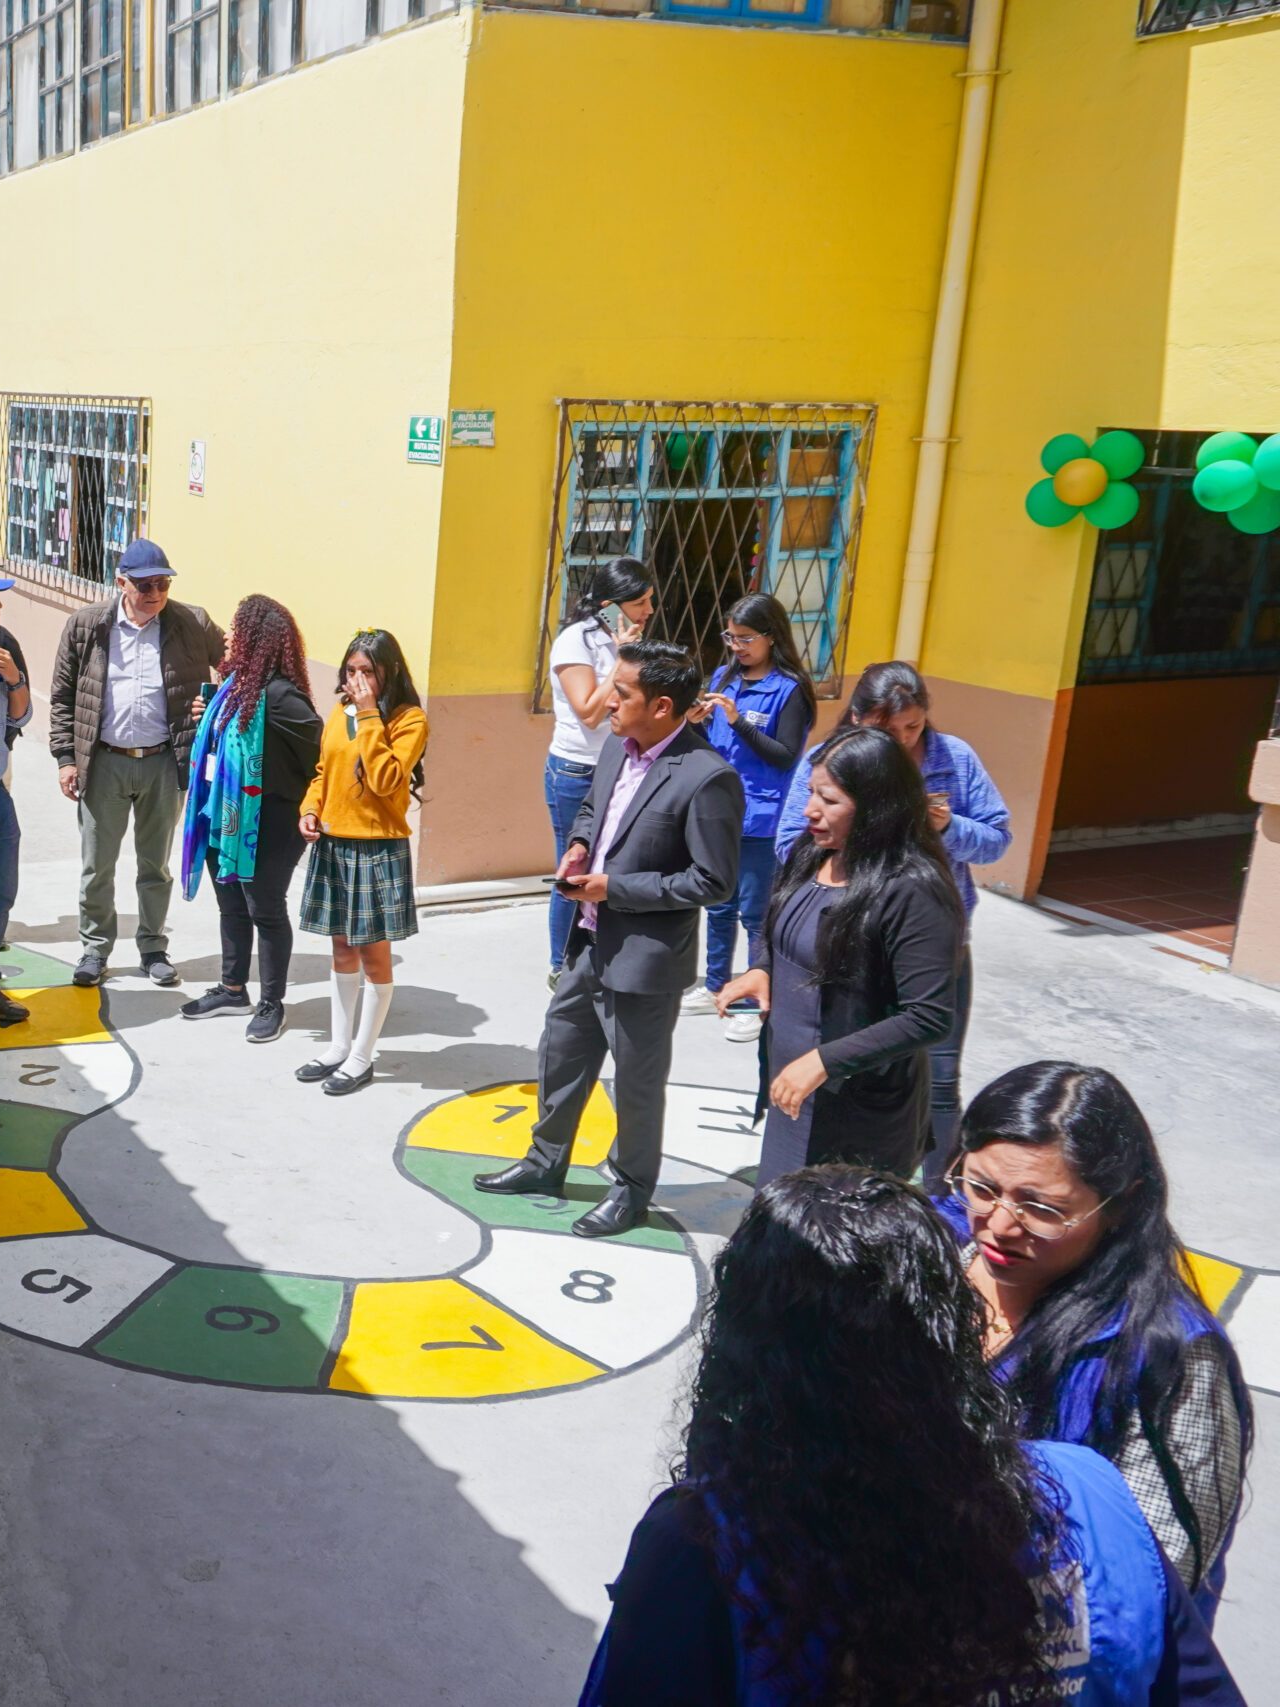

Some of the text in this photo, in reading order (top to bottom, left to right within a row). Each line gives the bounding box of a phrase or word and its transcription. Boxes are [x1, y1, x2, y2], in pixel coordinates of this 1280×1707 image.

[18, 1063, 61, 1086] 2
[21, 1268, 92, 1304] 5
[560, 1269, 617, 1304] 8
[204, 1304, 281, 1335] 6
[420, 1324, 506, 1352] 7
